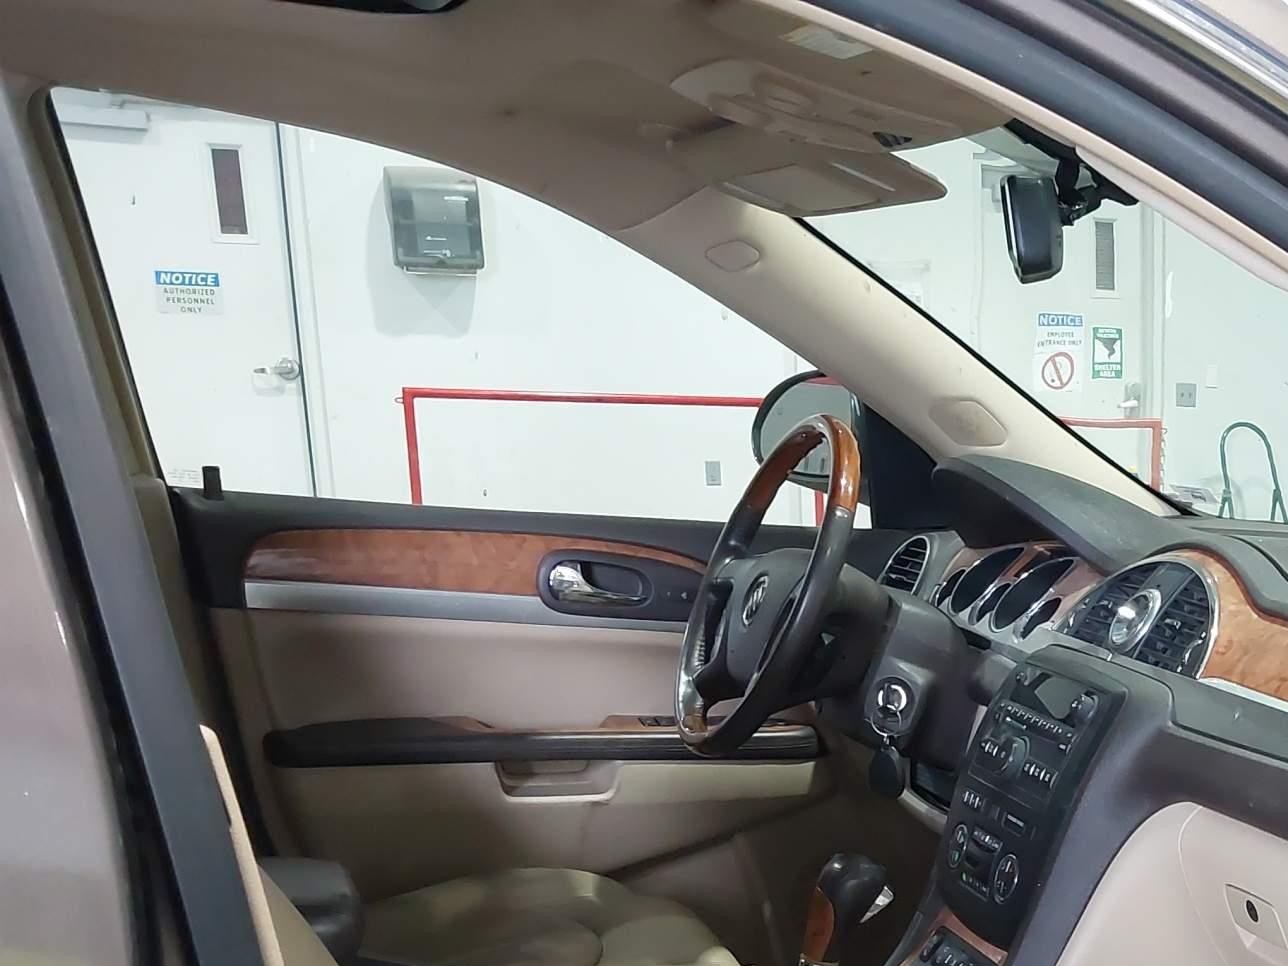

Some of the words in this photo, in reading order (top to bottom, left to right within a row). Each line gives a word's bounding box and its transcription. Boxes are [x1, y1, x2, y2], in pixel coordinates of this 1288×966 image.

[160, 272, 217, 286] NOTICE
[163, 287, 215, 296] AUTHORIZED
[166, 296, 215, 305] PERSONNEL
[1039, 314, 1082, 326] NOTICE
